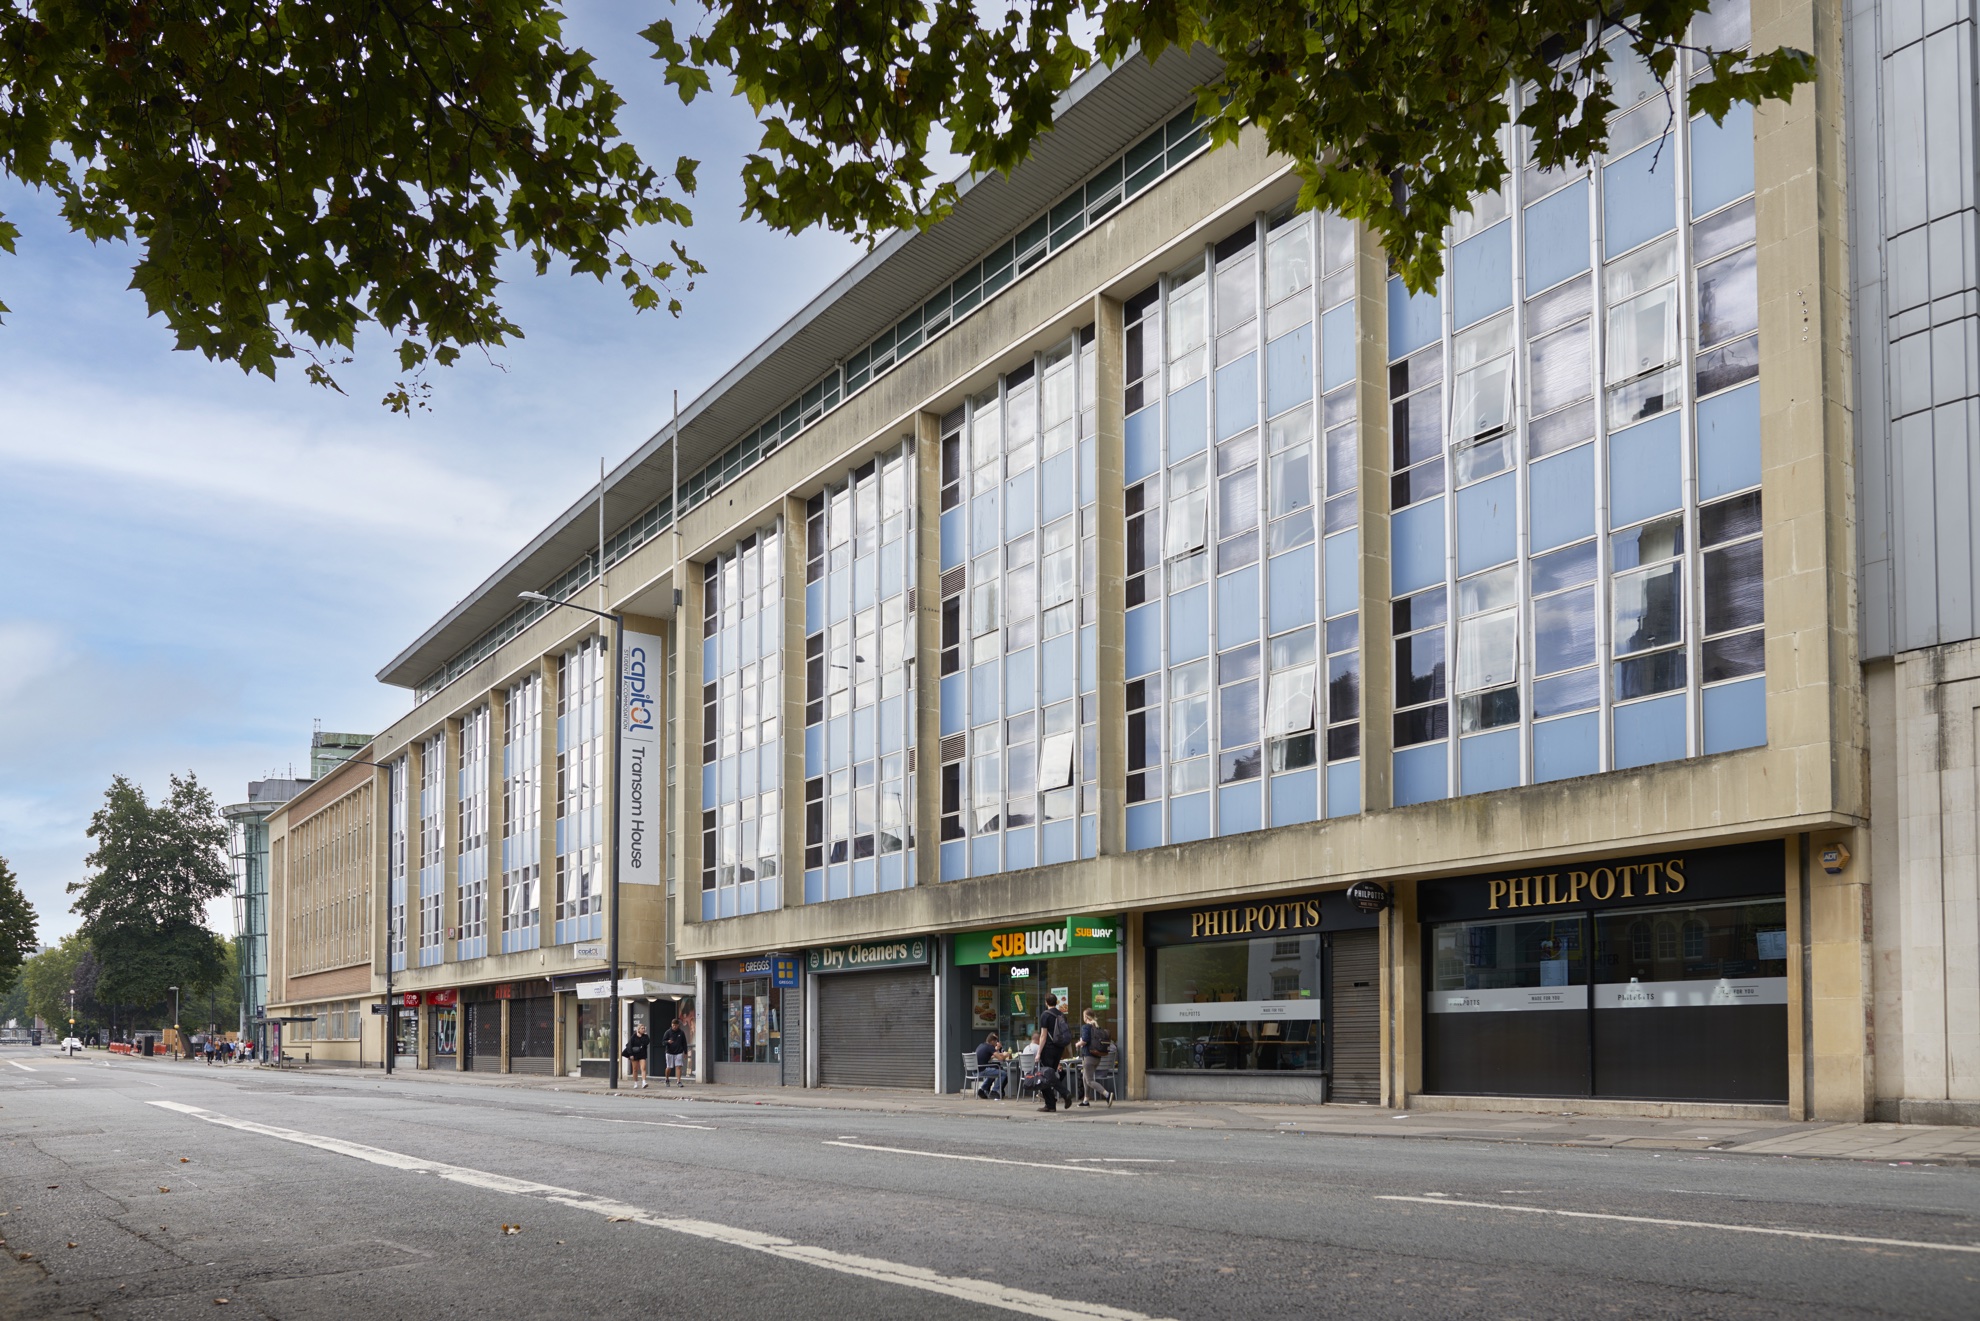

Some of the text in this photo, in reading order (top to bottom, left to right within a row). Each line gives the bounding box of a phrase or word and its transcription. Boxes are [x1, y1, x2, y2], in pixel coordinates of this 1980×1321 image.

[624, 647, 653, 732] capitol
[631, 747, 645, 869] Transom House
[1824, 852, 1838, 860] ADT
[1488, 858, 1687, 911] PHILPOTTS
[1354, 889, 1384, 900] PHILPOTTS
[1191, 899, 1322, 938] PHILPOTTS
[1074, 927, 1113, 938] SUBWAY
[988, 928, 1067, 959] SUBWAY
[823, 948, 845, 969] Dry
[848, 943, 908, 964] Cleaners
[745, 960, 769, 972] GREGGS
[1011, 966, 1030, 978] Open
[978, 989, 992, 998] BIG
